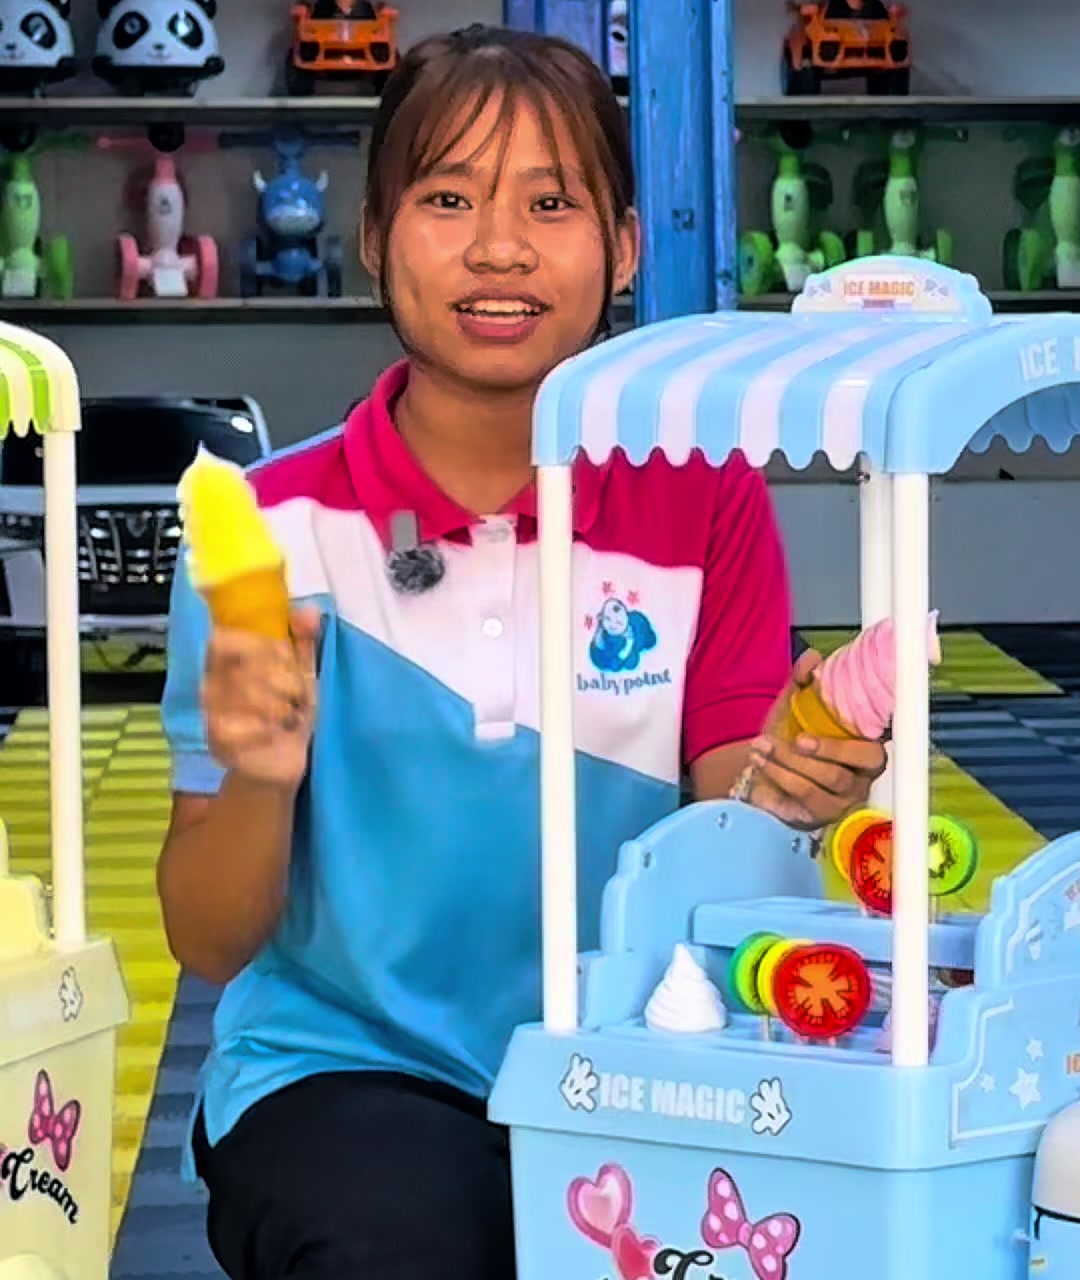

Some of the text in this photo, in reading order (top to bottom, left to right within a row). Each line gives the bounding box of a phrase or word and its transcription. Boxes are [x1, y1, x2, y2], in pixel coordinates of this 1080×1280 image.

[867, 280, 916, 297] MAGIC
[1018, 336, 1060, 383] ICE
[600, 1071, 746, 1125] ICE MAGIC
[1, 1147, 79, 1225] Cream
